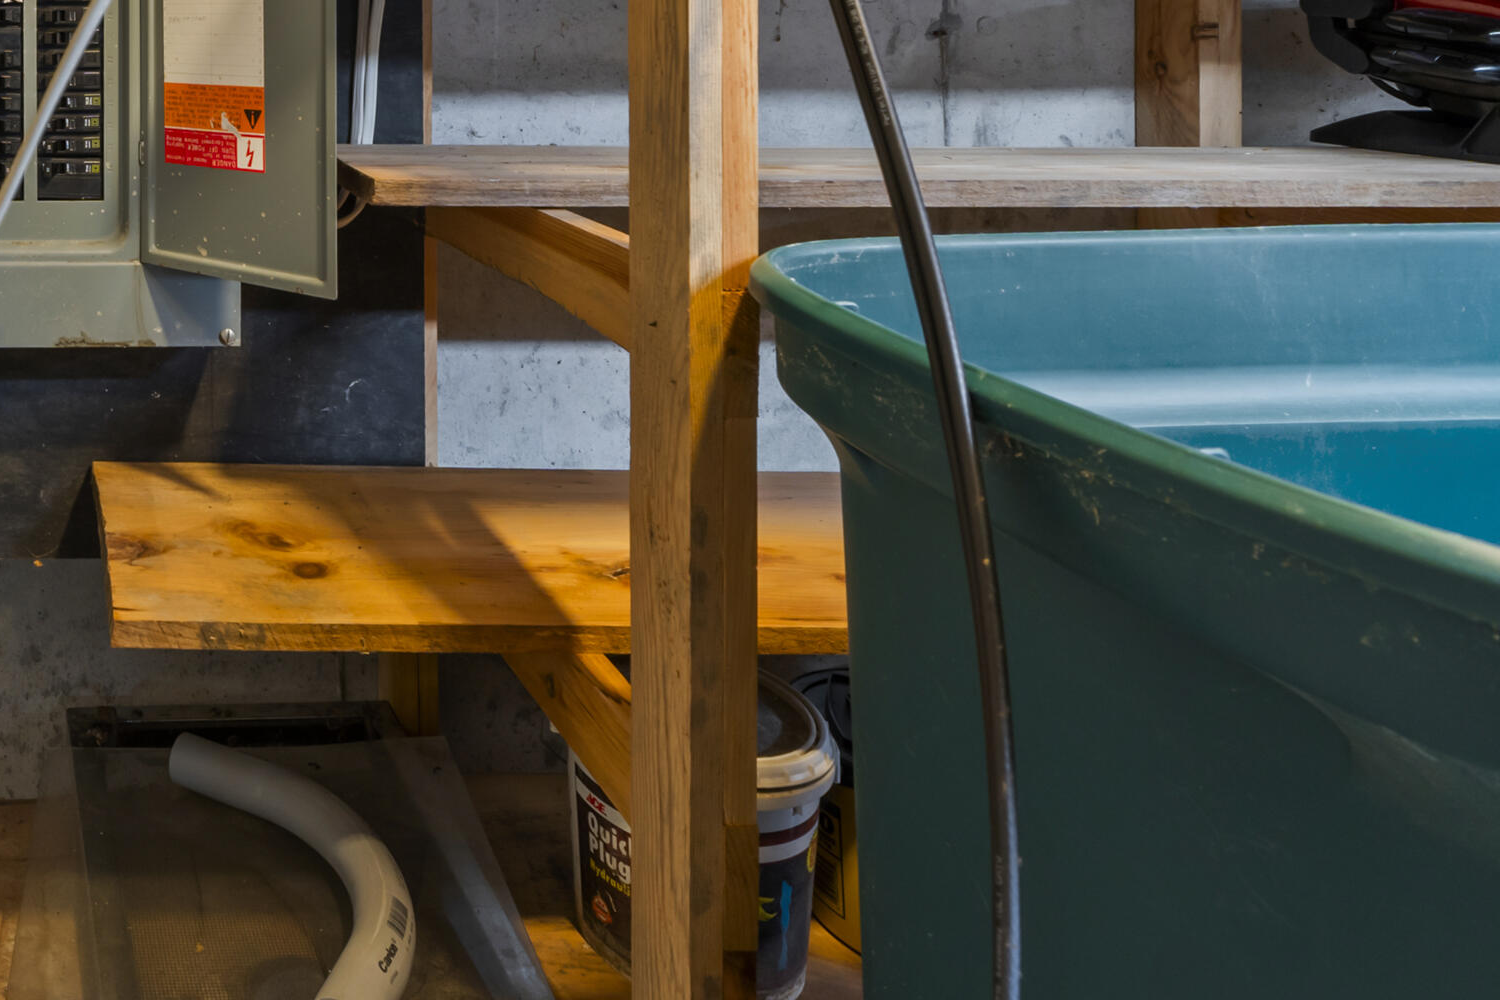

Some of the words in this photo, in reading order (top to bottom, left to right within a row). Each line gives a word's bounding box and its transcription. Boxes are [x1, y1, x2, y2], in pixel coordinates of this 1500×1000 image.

[586, 793, 605, 814] ACE
[588, 831, 631, 885] Plug
[589, 857, 631, 897] Hydrauli
